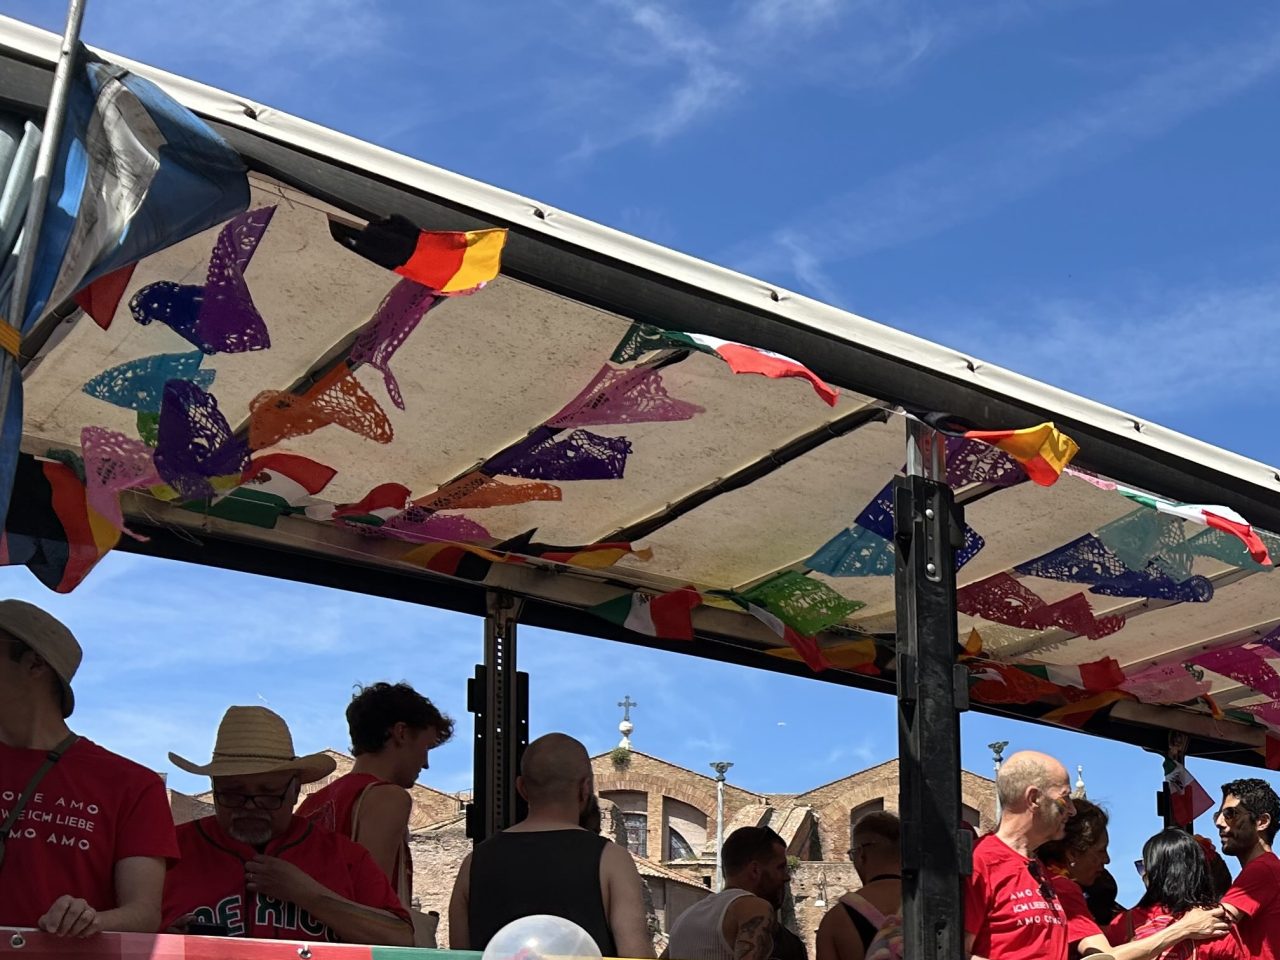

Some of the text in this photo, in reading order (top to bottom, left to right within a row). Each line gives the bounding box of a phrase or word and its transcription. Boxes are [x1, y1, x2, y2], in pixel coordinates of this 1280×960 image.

[55, 797, 99, 814] AMO
[56, 814, 95, 832] LIEBE
[47, 833, 90, 850] AMO
[1011, 889, 1033, 900] AMO
[1017, 915, 1041, 925] AMO
